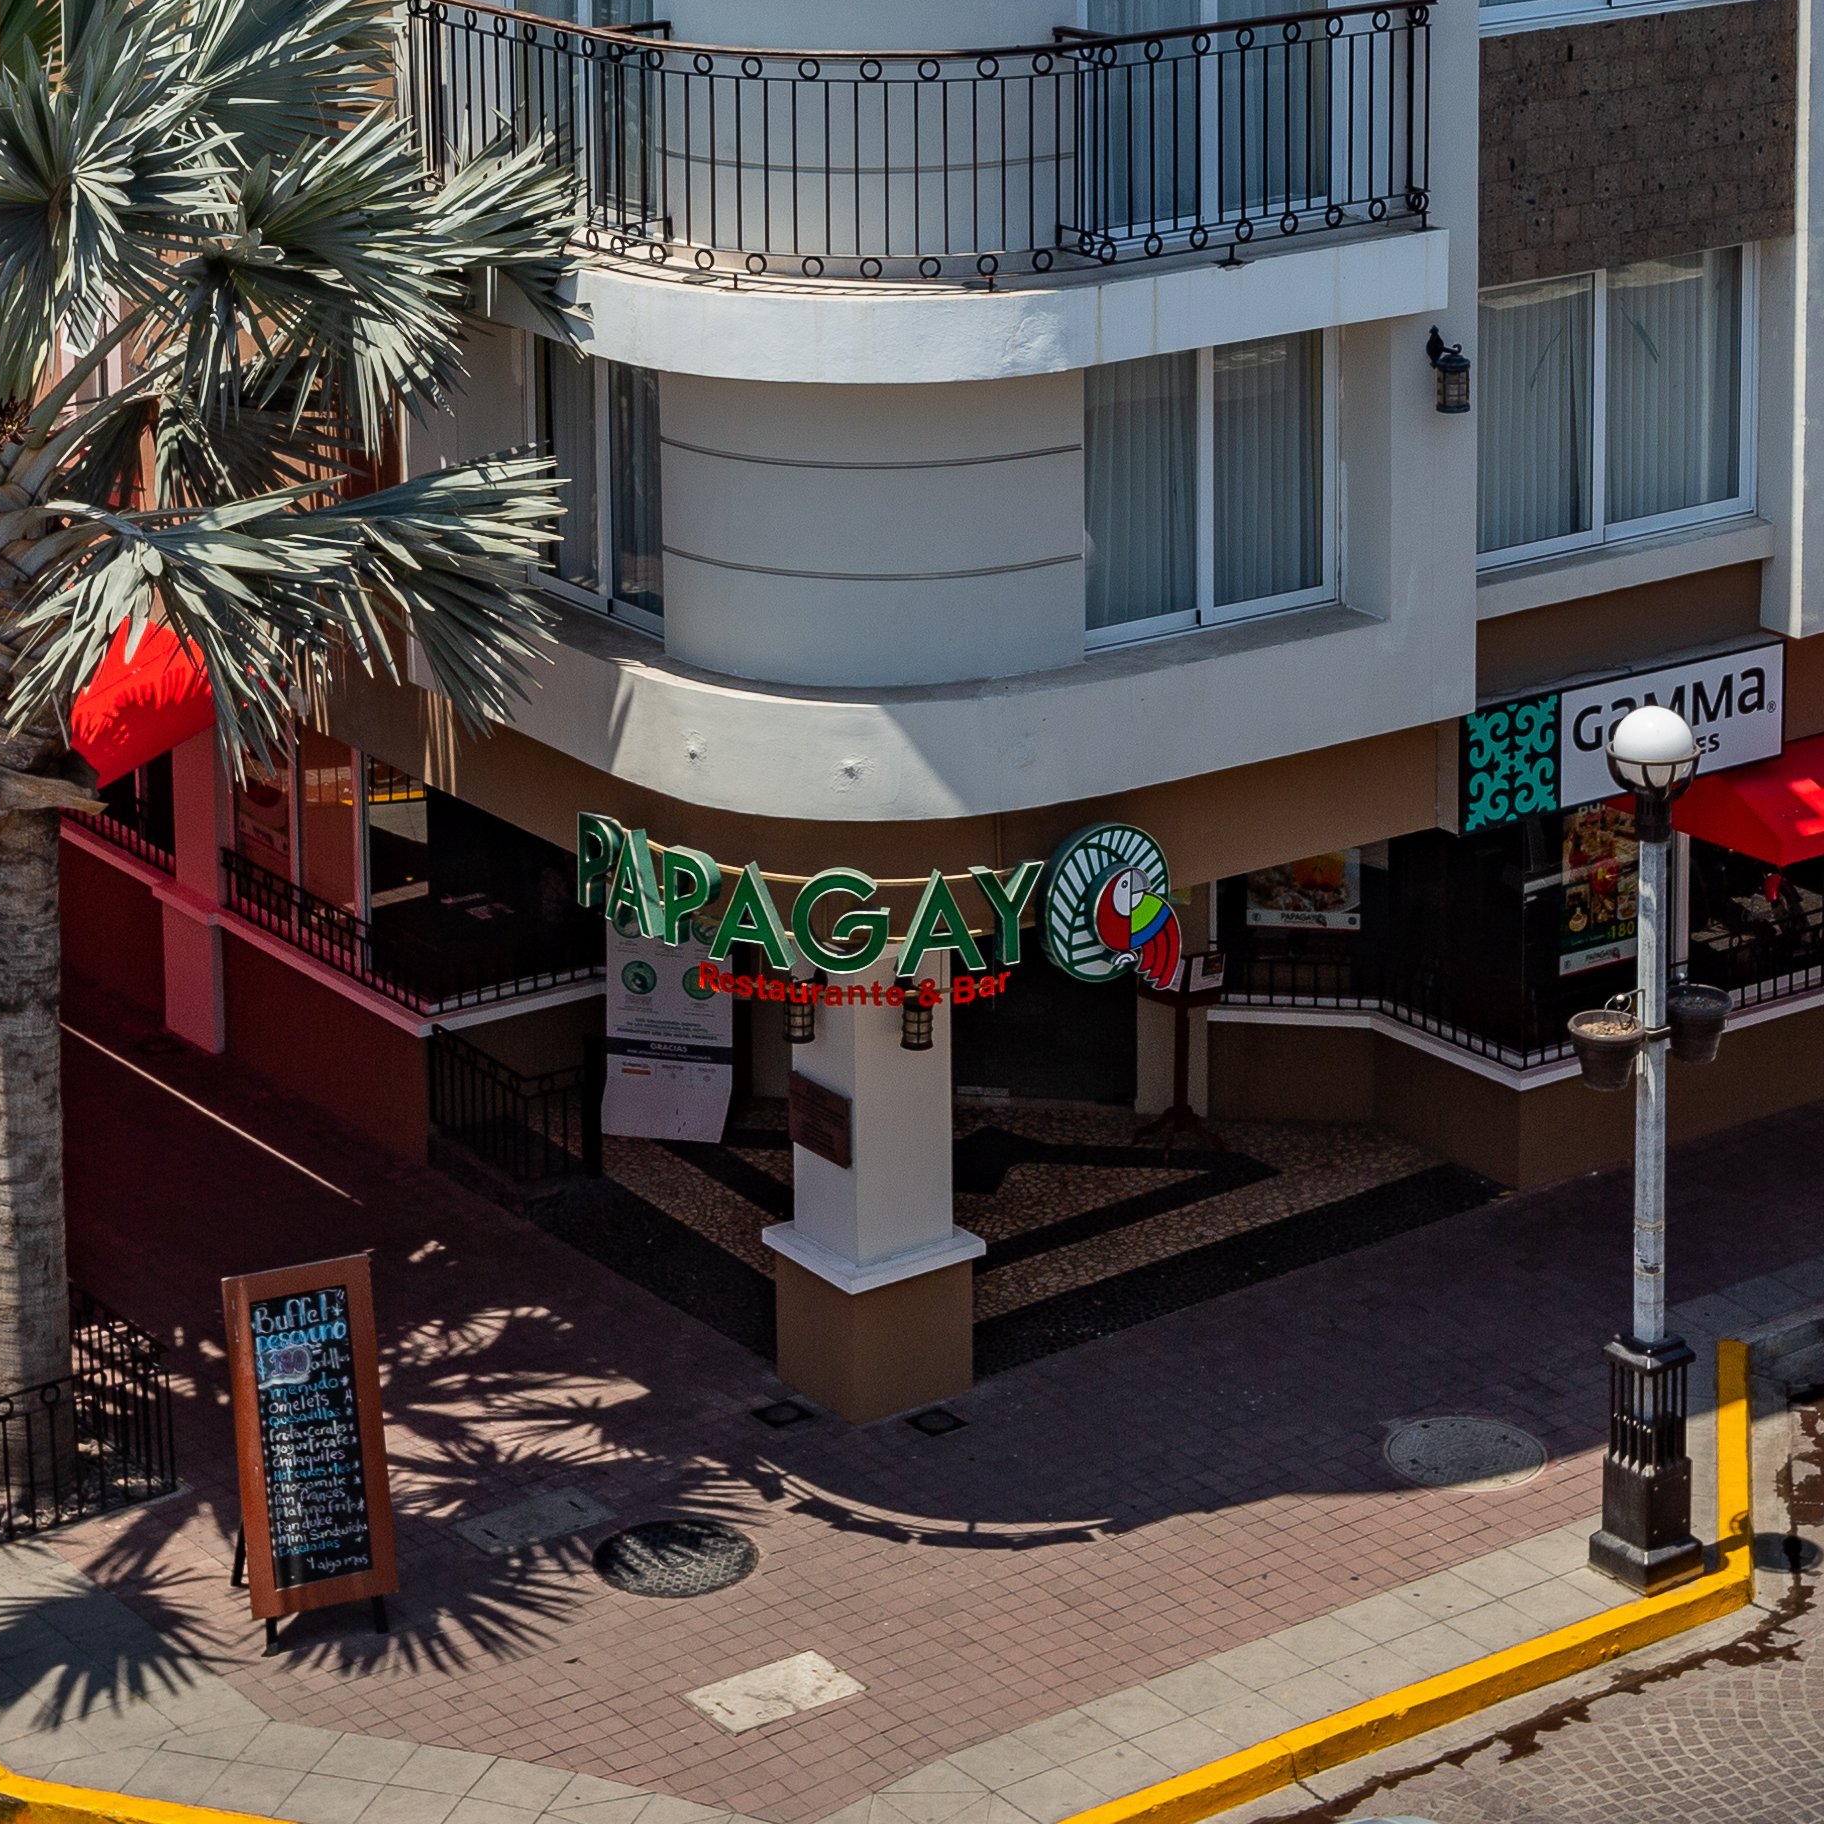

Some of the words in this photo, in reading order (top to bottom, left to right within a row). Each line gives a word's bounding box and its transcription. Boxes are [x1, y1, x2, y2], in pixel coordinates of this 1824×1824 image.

[698, 960, 905, 1008] Restaurante
[917, 978, 944, 1007] &
[952, 970, 1012, 1005] Bar
